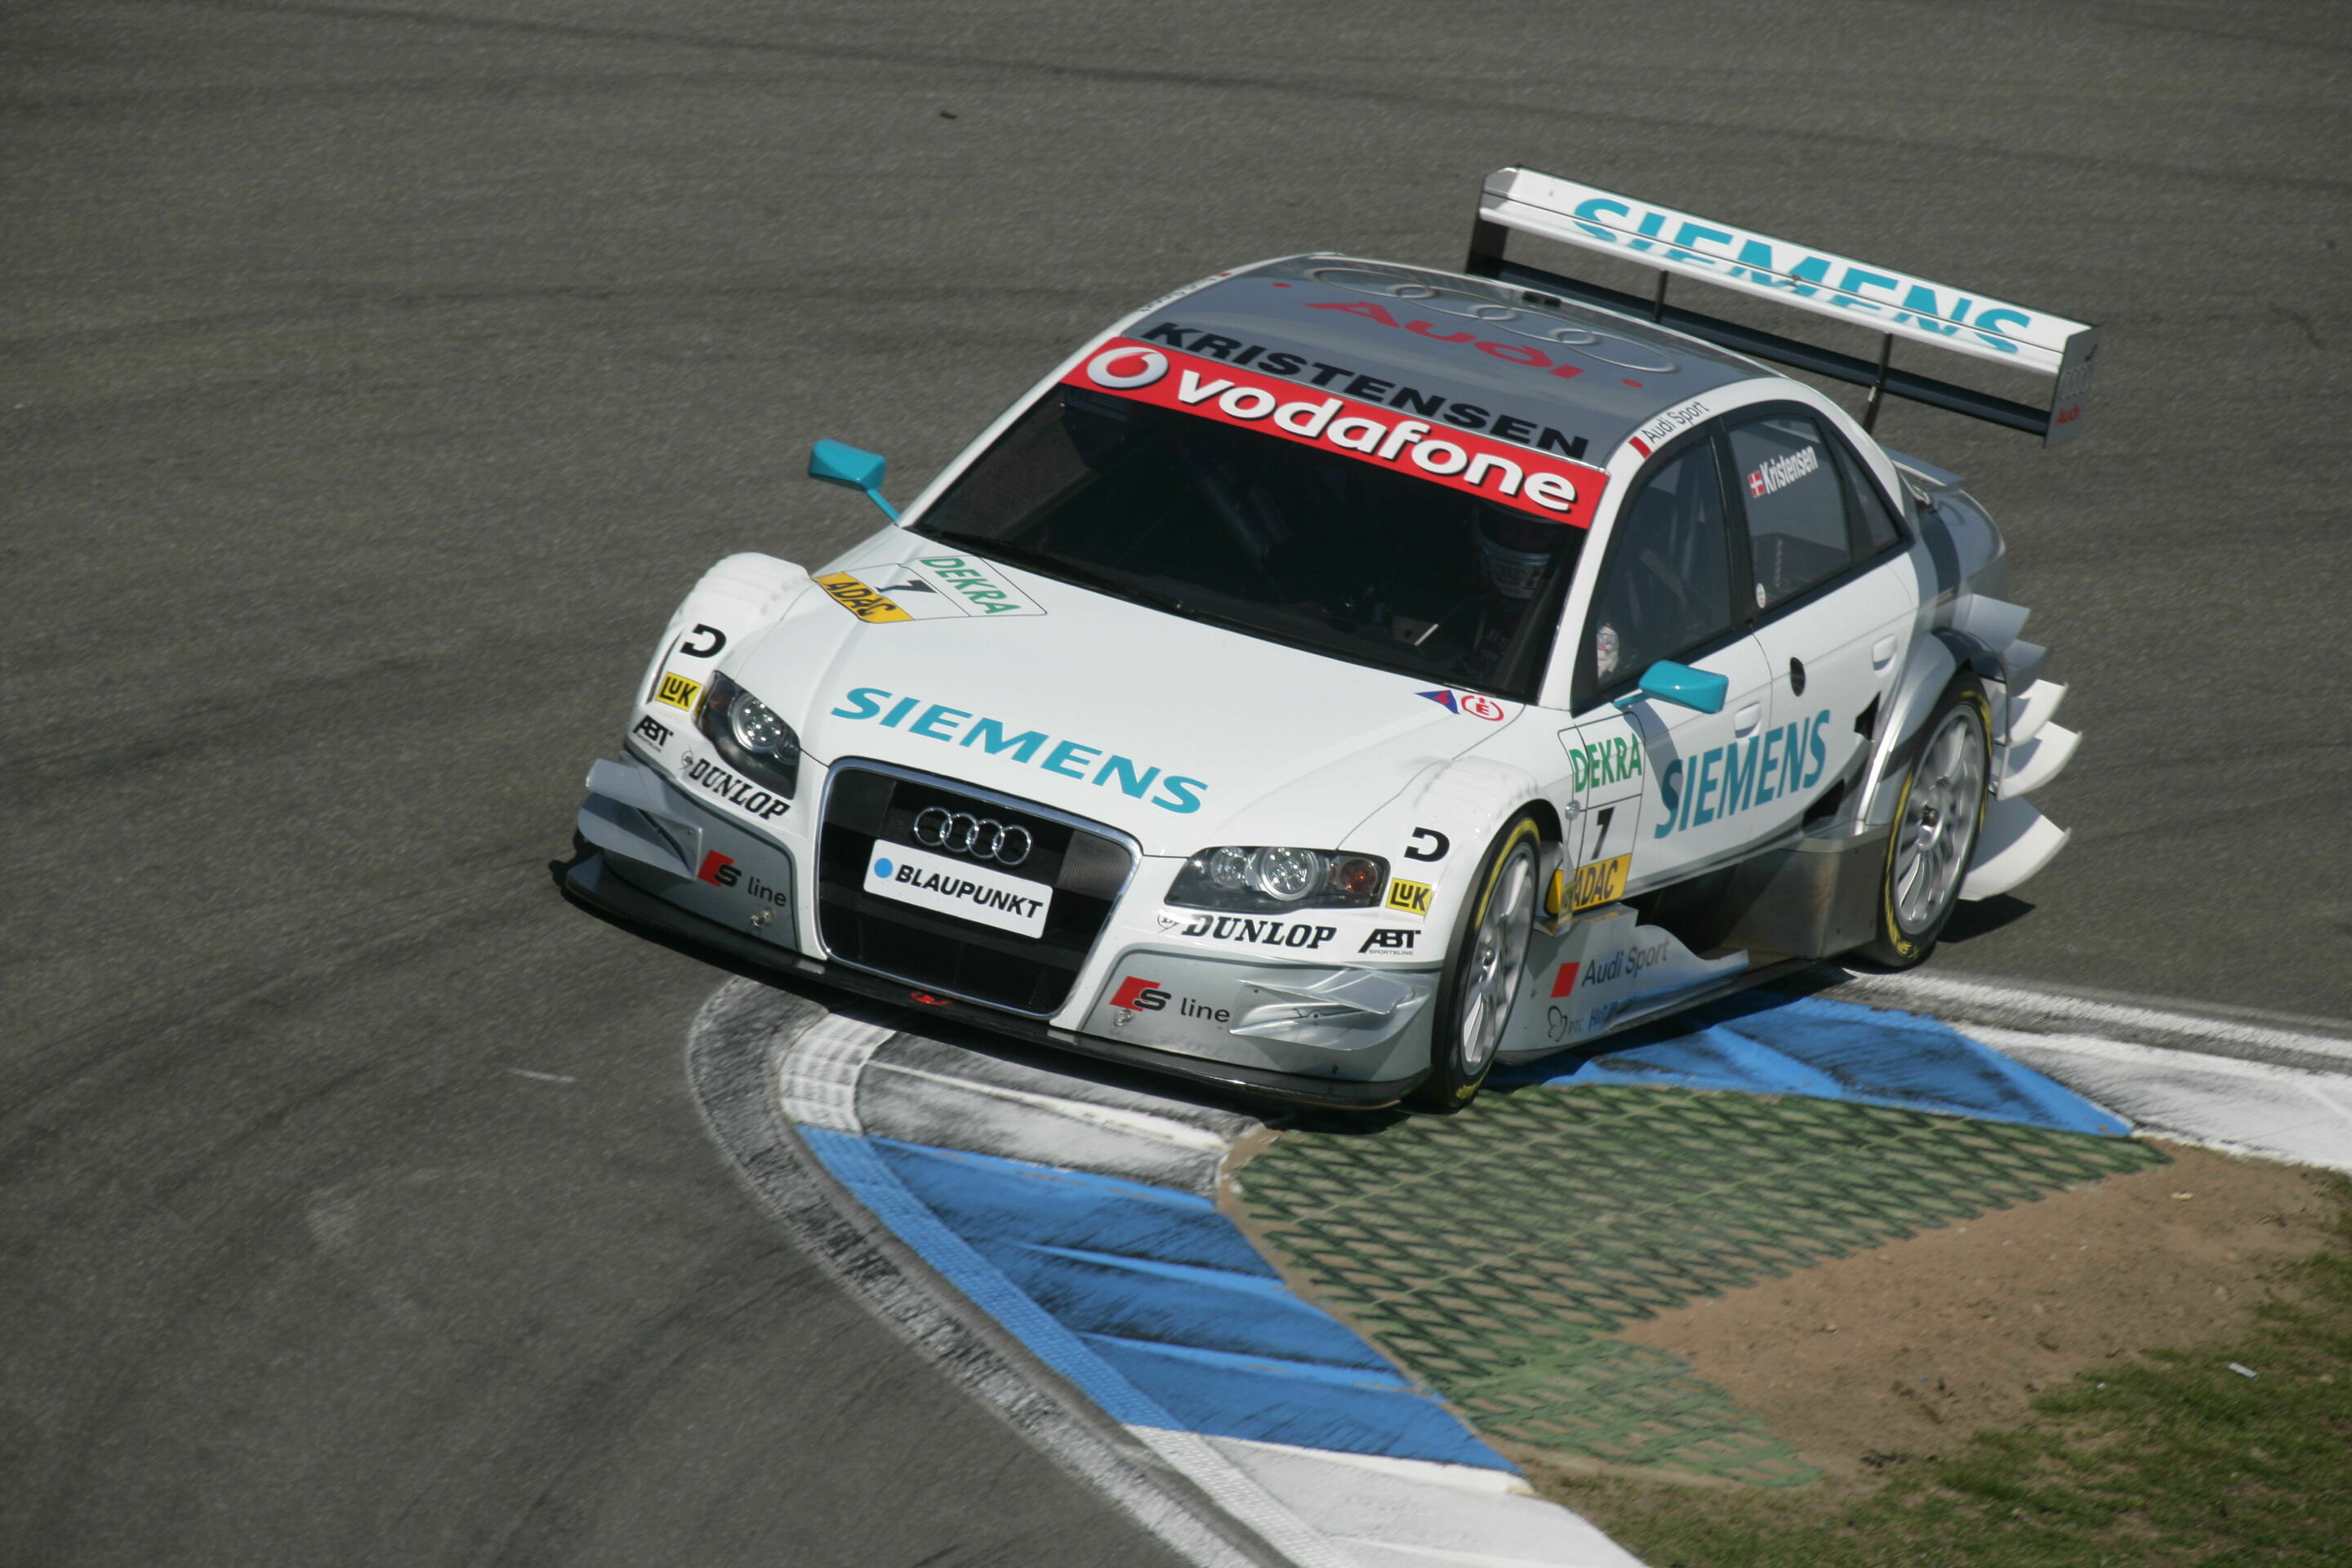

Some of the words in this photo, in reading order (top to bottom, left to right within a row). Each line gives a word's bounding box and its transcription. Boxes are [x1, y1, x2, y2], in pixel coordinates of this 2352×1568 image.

[1574, 198, 2032, 354] SIEMENS
[1300, 300, 1585, 379] Audi
[1140, 322, 1589, 460] KRISTENSEN
[1177, 369, 1577, 512] vodafone
[1642, 416, 1674, 443] Audi
[1669, 401, 1710, 426] Sport
[1760, 445, 1819, 495] Kristensen
[825, 582, 897, 617] ADAC
[875, 580, 938, 594] 7
[920, 557, 1021, 614] DEKRA
[633, 715, 674, 746] ABT
[830, 687, 1209, 813] SIEMENS
[1569, 733, 1642, 792] DEKRA
[1655, 710, 1830, 839] SIEMENS
[688, 758, 791, 820] DUNLOP
[714, 864, 742, 887] S
[747, 876, 786, 906] line
[895, 864, 1044, 920] BLAUPUNKT
[1575, 859, 1618, 907] ADAC
[1181, 914, 1338, 950] DUNLOP
[1357, 928, 1421, 954] ABT
[1581, 950, 1624, 987] Audi
[1625, 940, 1670, 978] Sport
[1133, 987, 1172, 1011] S
[1180, 997, 1231, 1023] line
